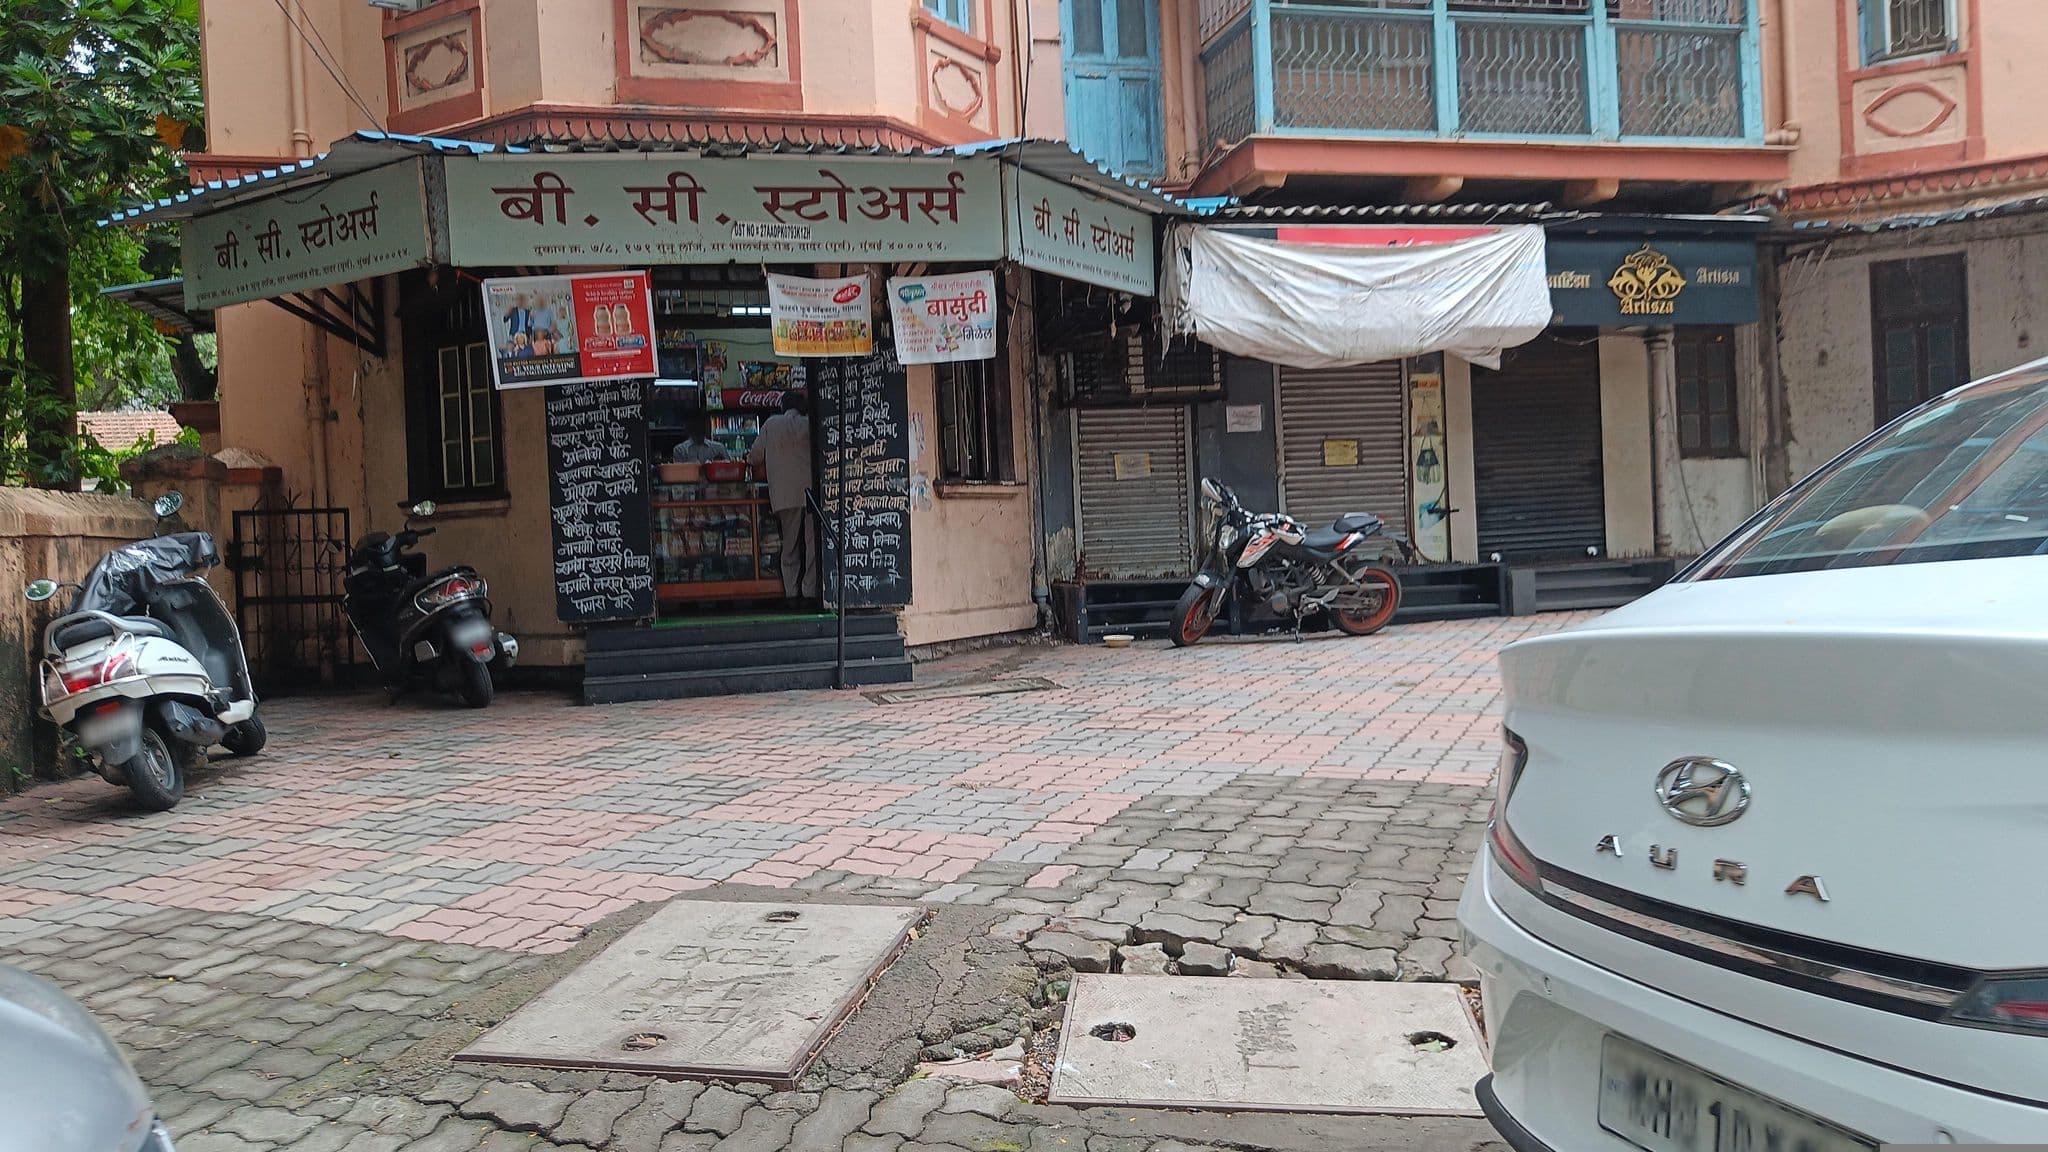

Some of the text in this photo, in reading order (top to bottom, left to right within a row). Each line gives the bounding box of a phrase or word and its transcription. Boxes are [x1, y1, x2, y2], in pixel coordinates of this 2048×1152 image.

[492, 169, 966, 226] बी. सी. स्टोअर्स
[214, 190, 379, 270] बी. सी. स्टोअर्स
[1033, 197, 1135, 264] बी. सी. स्टोअर्स
[925, 290, 988, 321] बासुंदी
[1619, 298, 1675, 315] Artisza
[1595, 833, 1832, 903] AURA
